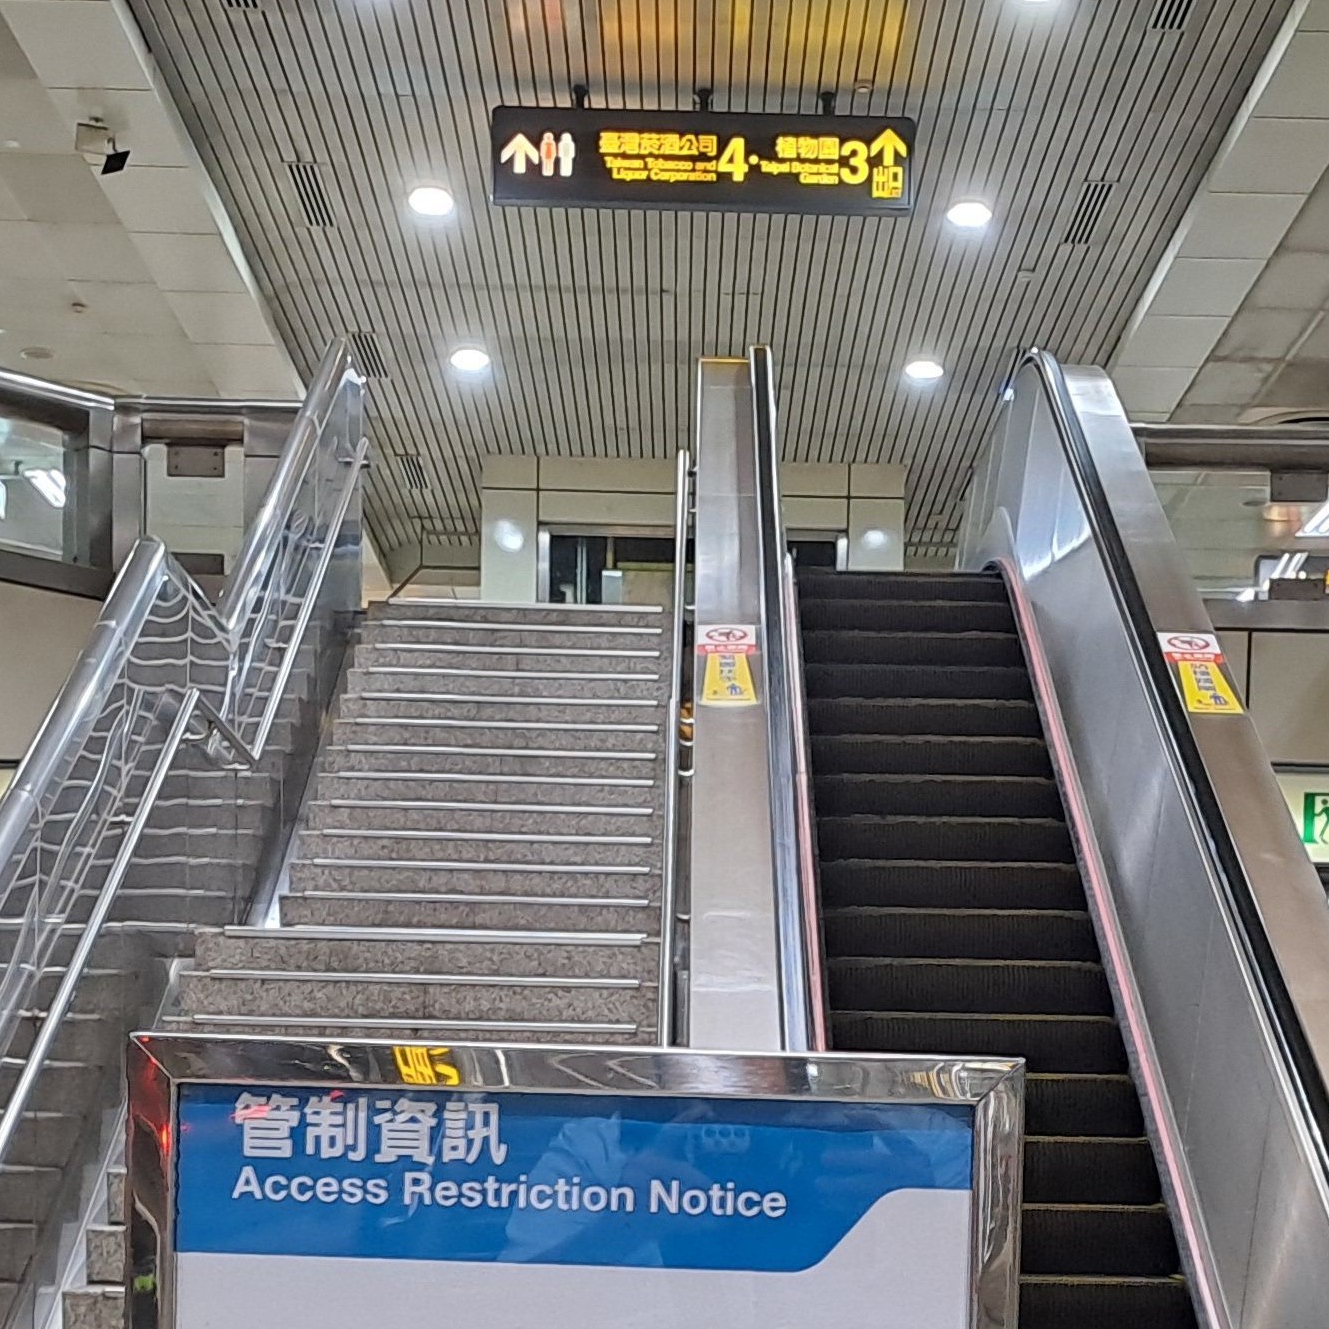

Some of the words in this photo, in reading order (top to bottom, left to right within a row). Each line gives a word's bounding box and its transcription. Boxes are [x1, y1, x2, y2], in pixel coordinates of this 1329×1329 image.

[645, 158, 693, 170] Tobacco
[718, 137, 749, 182] 4
[776, 136, 839, 159] 植物園
[840, 140, 869, 184] 3
[650, 169, 717, 182] Corporation
[234, 1092, 509, 1166] 管制資訊
[231, 1166, 389, 1206] Access
[403, 1171, 634, 1213] Restriction
[648, 1178, 787, 1218] Notice
